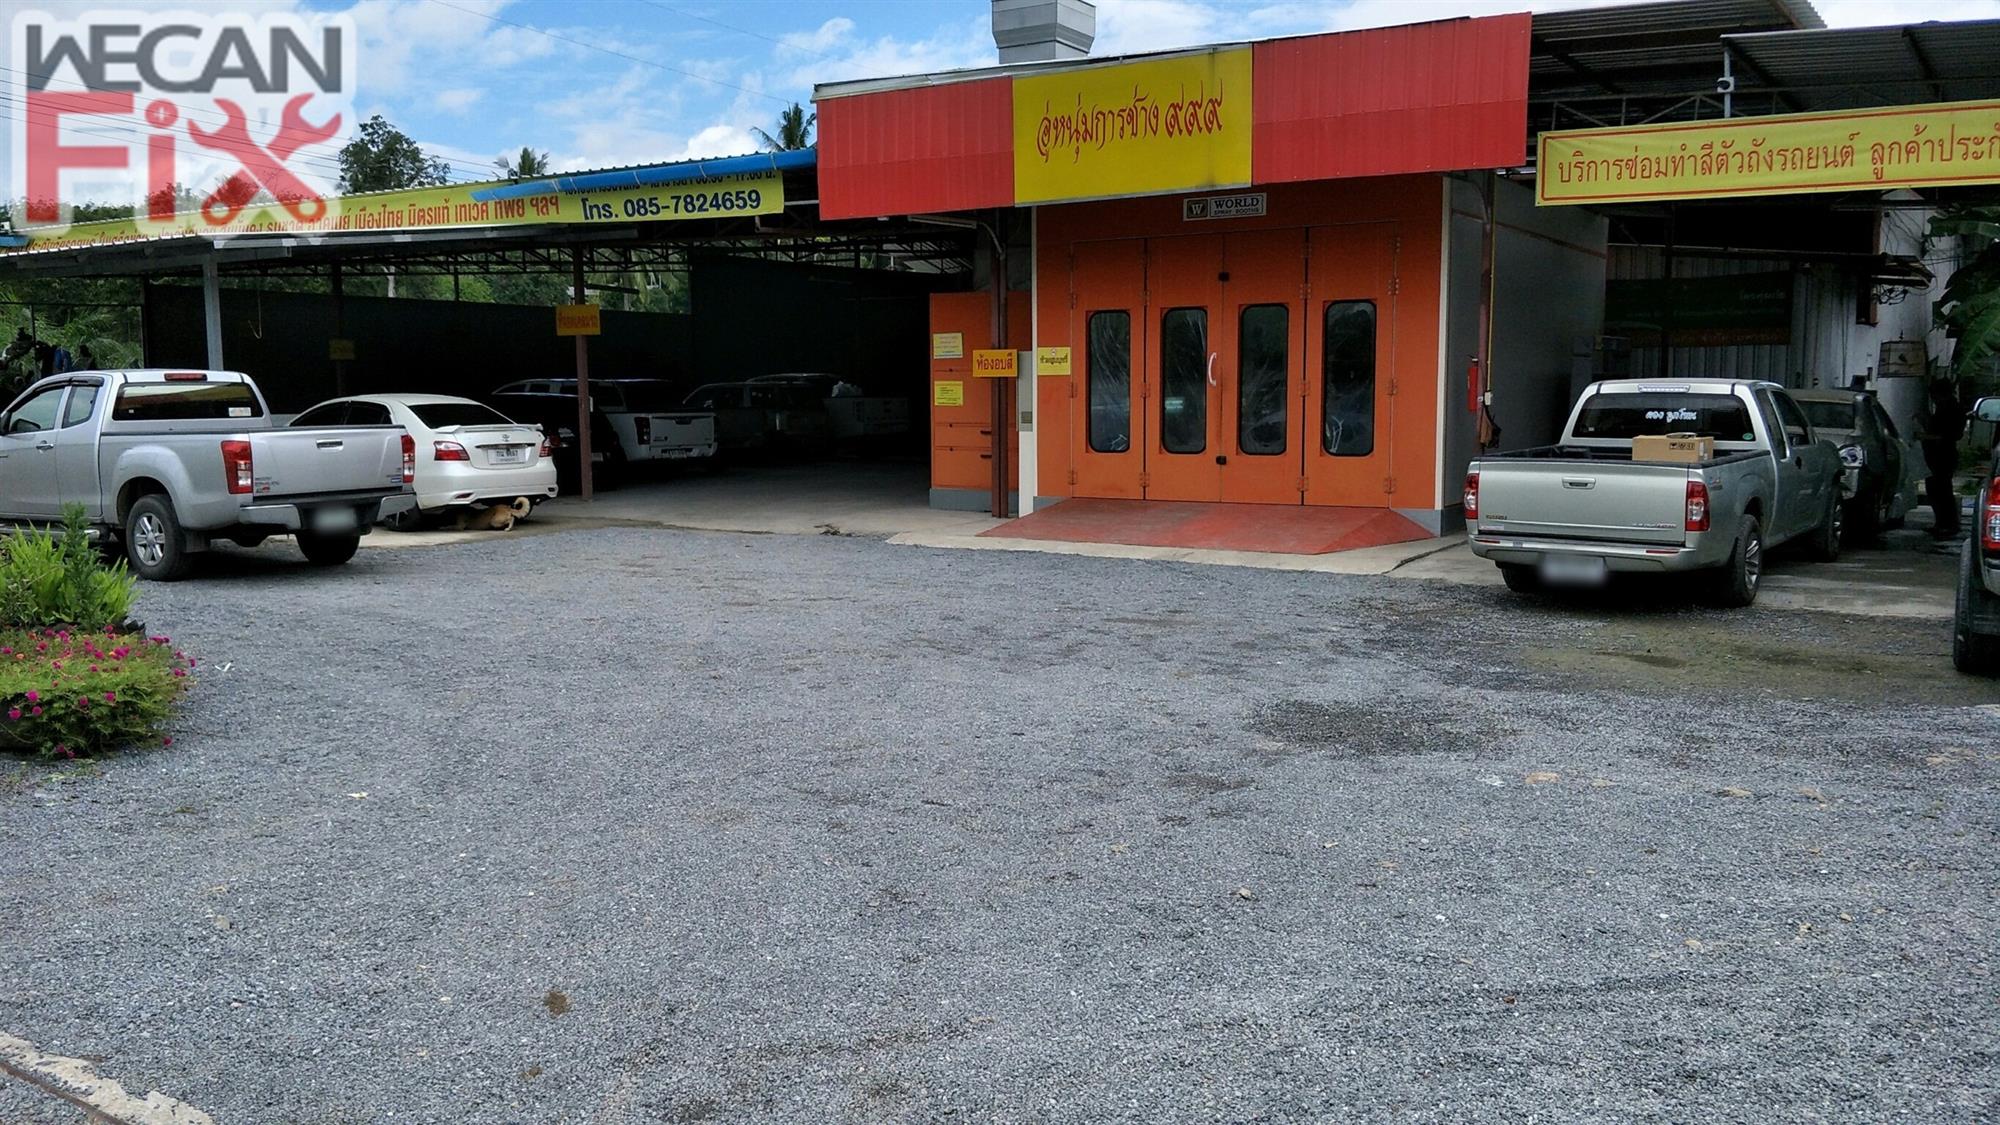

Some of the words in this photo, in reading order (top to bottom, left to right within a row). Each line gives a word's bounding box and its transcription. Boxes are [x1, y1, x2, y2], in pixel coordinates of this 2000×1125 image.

[1165, 78, 1223, 138] ๙๙๙
[1558, 131, 1860, 185] บริการซ่อมทำสีตัวถังรถยนต์
[408, 198, 450, 227] มิตรแท้
[582, 197, 618, 221] โทร.
[624, 189, 761, 218] 085-7824659
[1214, 197, 1260, 209] WORLD
